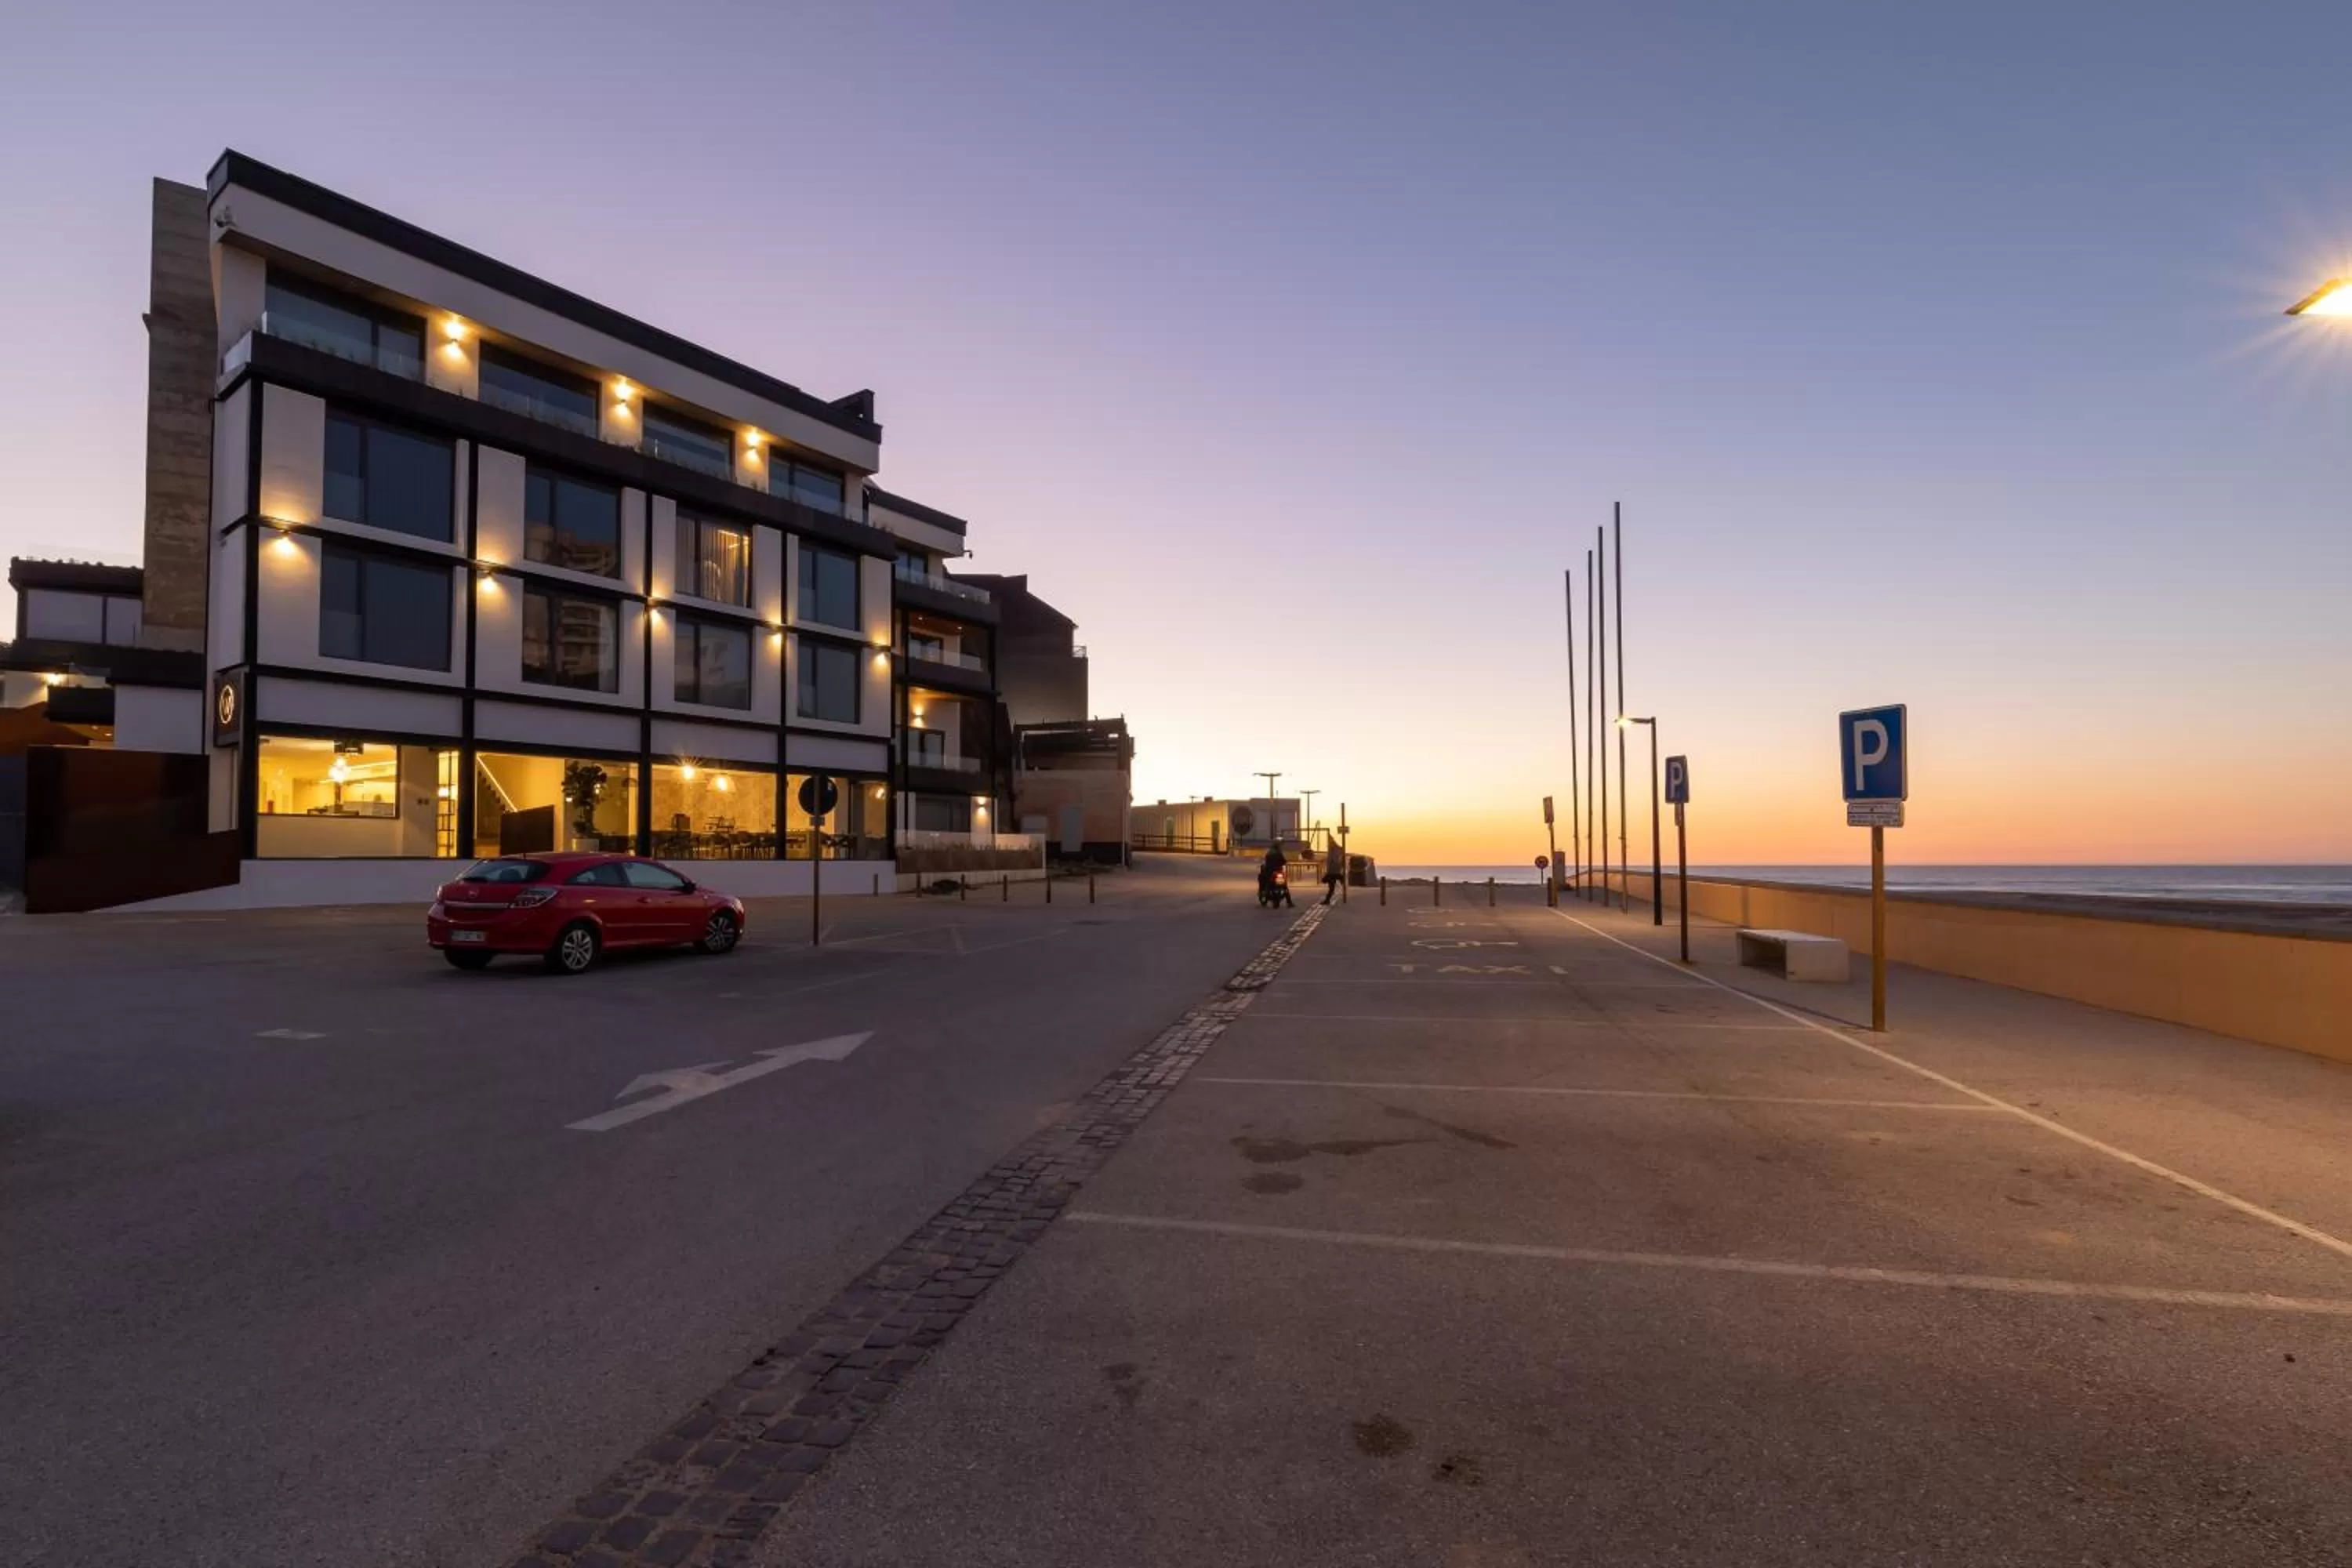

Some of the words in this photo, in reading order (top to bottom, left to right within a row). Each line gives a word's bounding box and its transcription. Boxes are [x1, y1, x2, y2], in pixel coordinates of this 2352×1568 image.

[1853, 719, 1889, 790] P
[1670, 761, 1683, 798] P
[1388, 964, 1568, 975] TAXI
